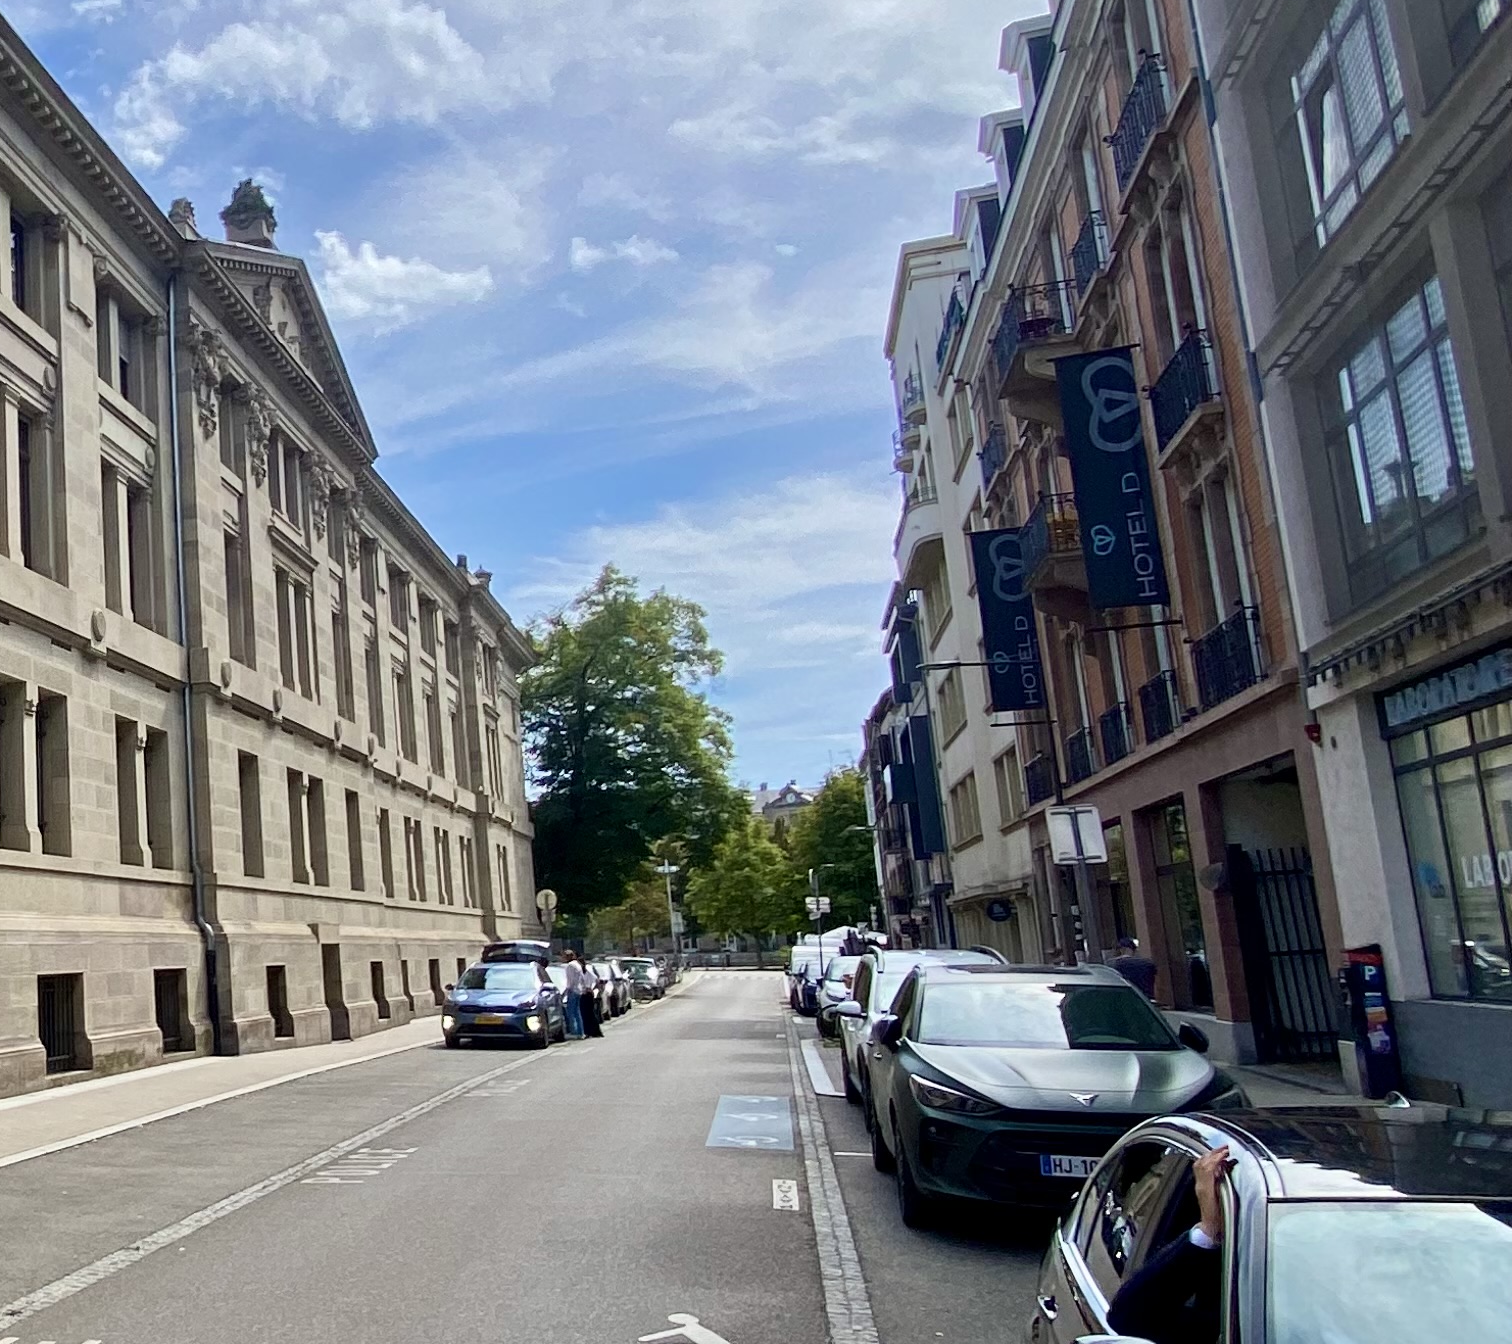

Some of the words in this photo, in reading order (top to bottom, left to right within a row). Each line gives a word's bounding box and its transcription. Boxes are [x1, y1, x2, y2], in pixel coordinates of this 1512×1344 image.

[1121, 472, 1140, 493] D
[1126, 498, 1158, 597] HOTEL
[1015, 616, 1029, 631] D
[1018, 634, 1039, 704] HOTEL
[1461, 850, 1512, 888] LABO
[1364, 965, 1376, 980] P
[300, 1147, 419, 1183] POLICE
